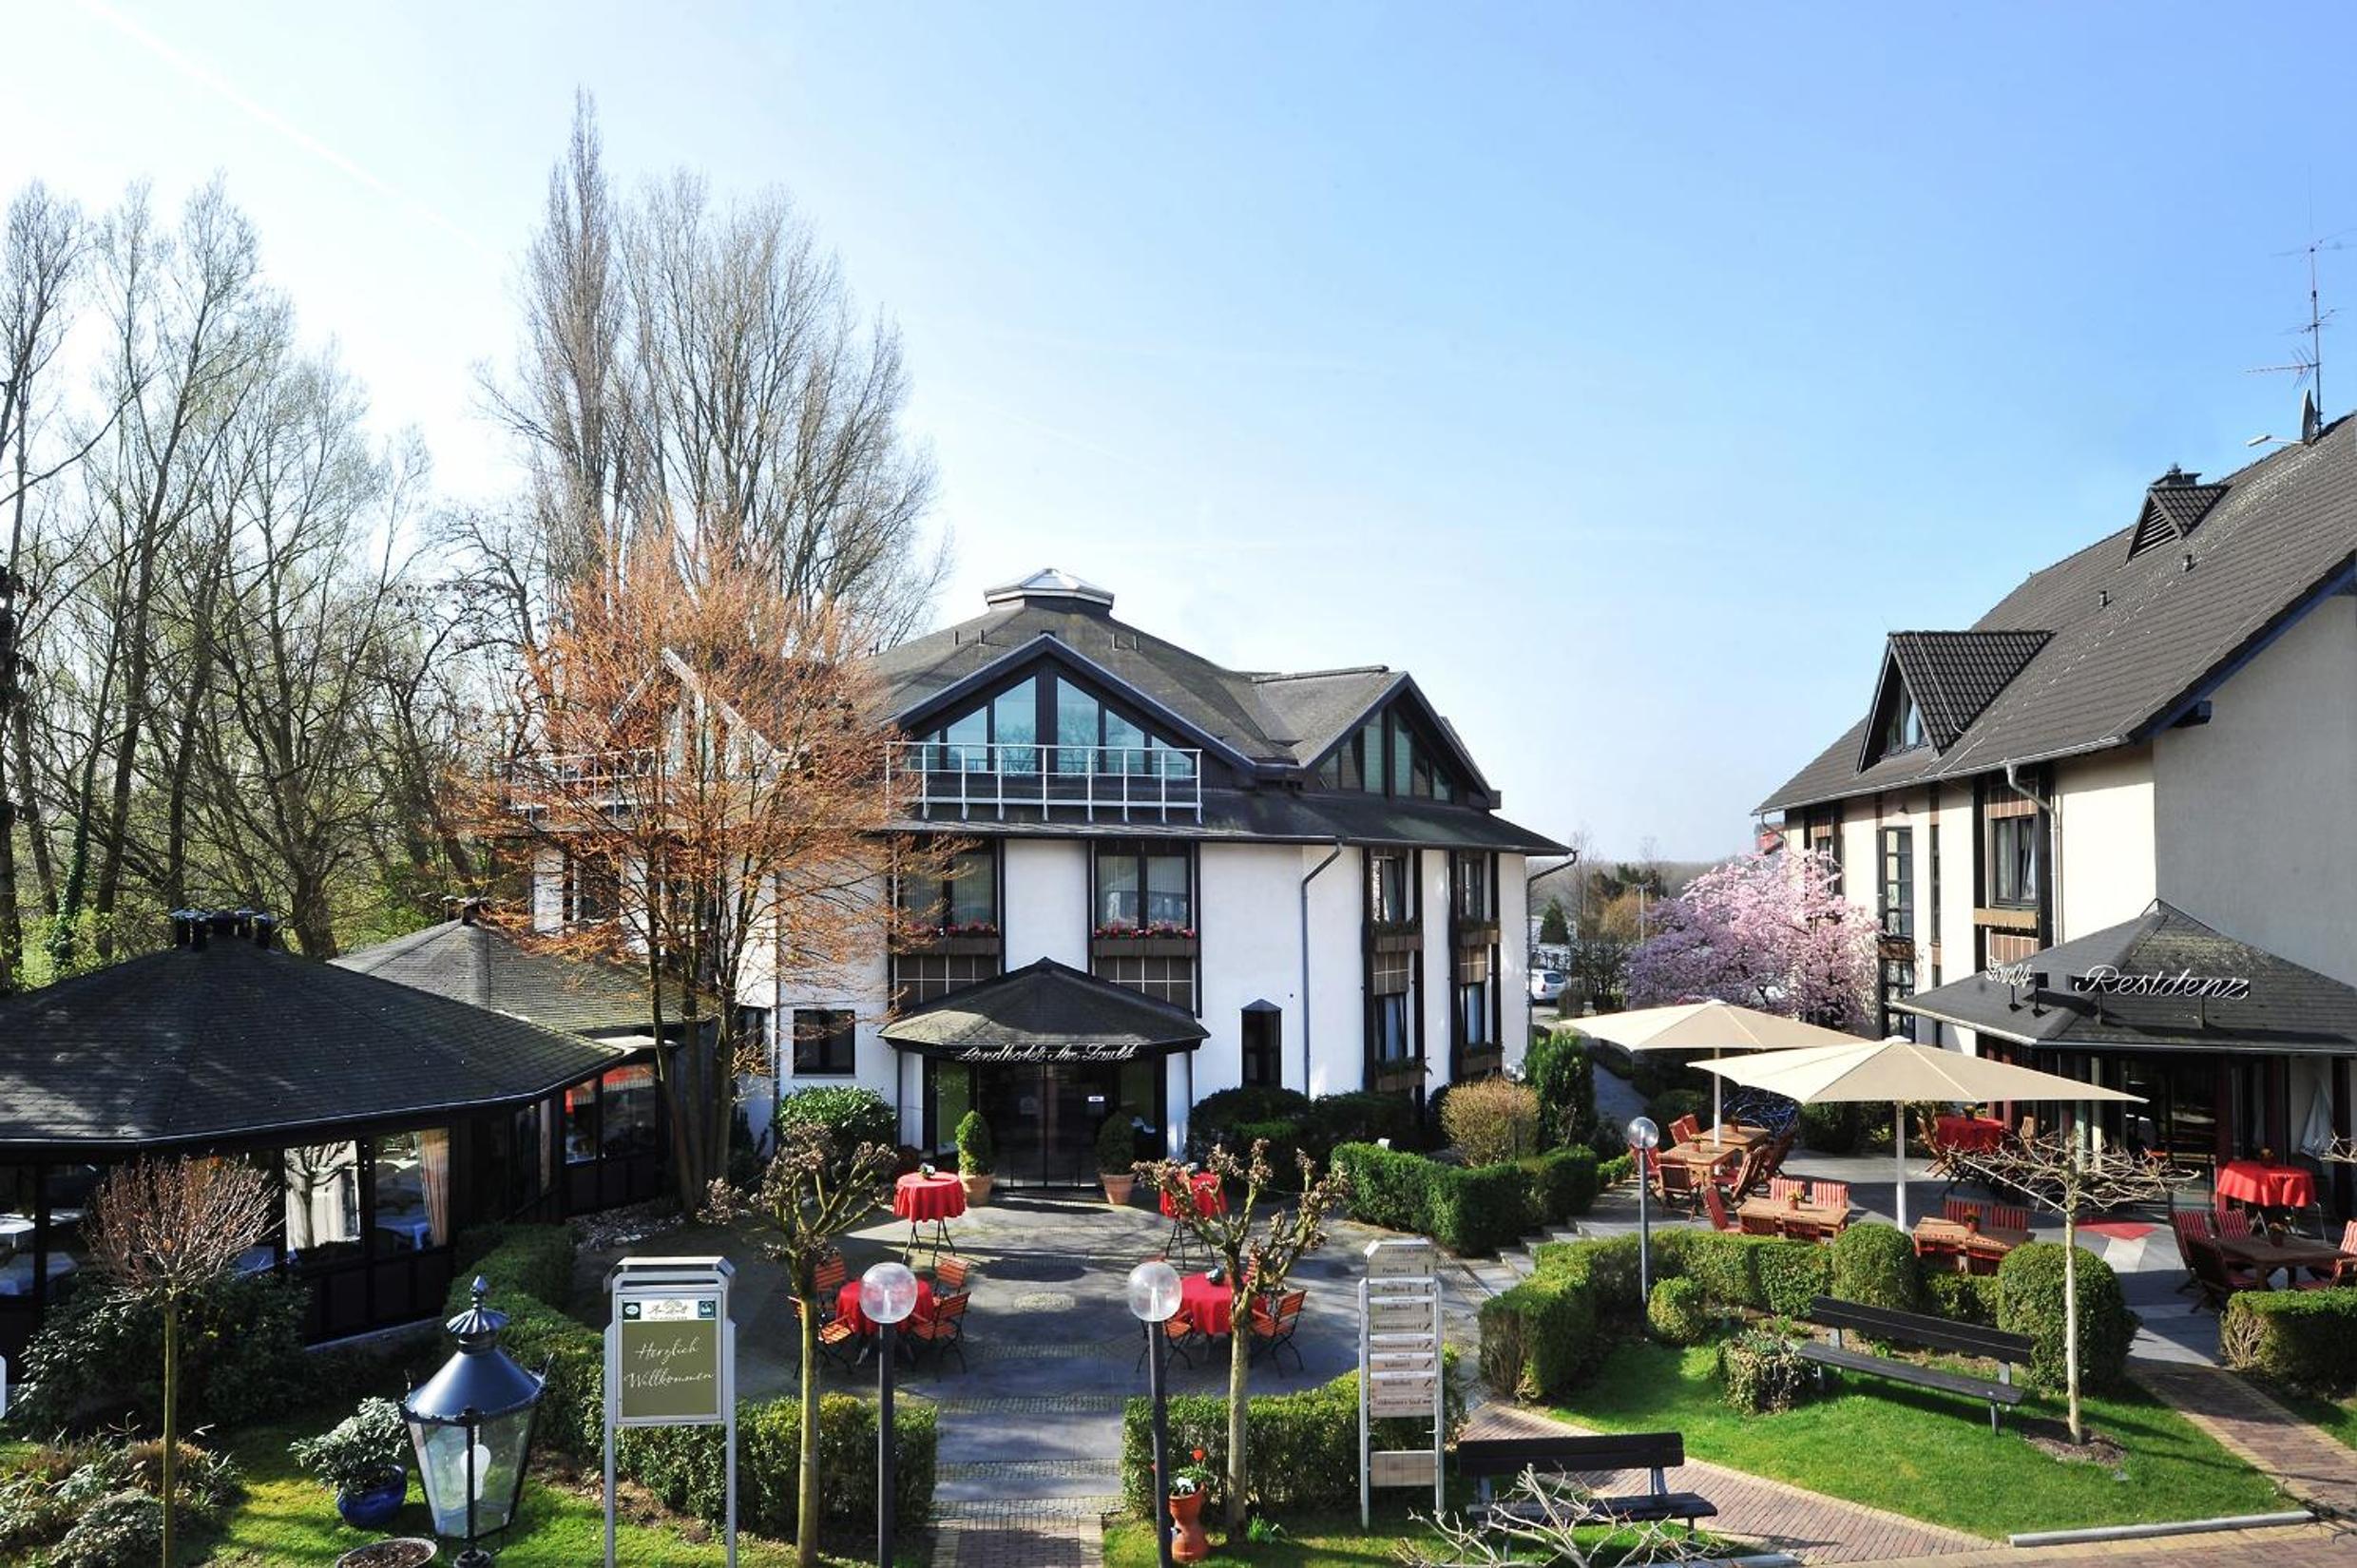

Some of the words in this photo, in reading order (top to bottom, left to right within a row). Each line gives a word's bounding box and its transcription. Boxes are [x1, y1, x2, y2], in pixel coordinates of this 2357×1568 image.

[2075, 964, 2250, 1001] Residenz
[635, 1337, 700, 1365] Herzlich
[623, 1367, 716, 1388] Willkommen
